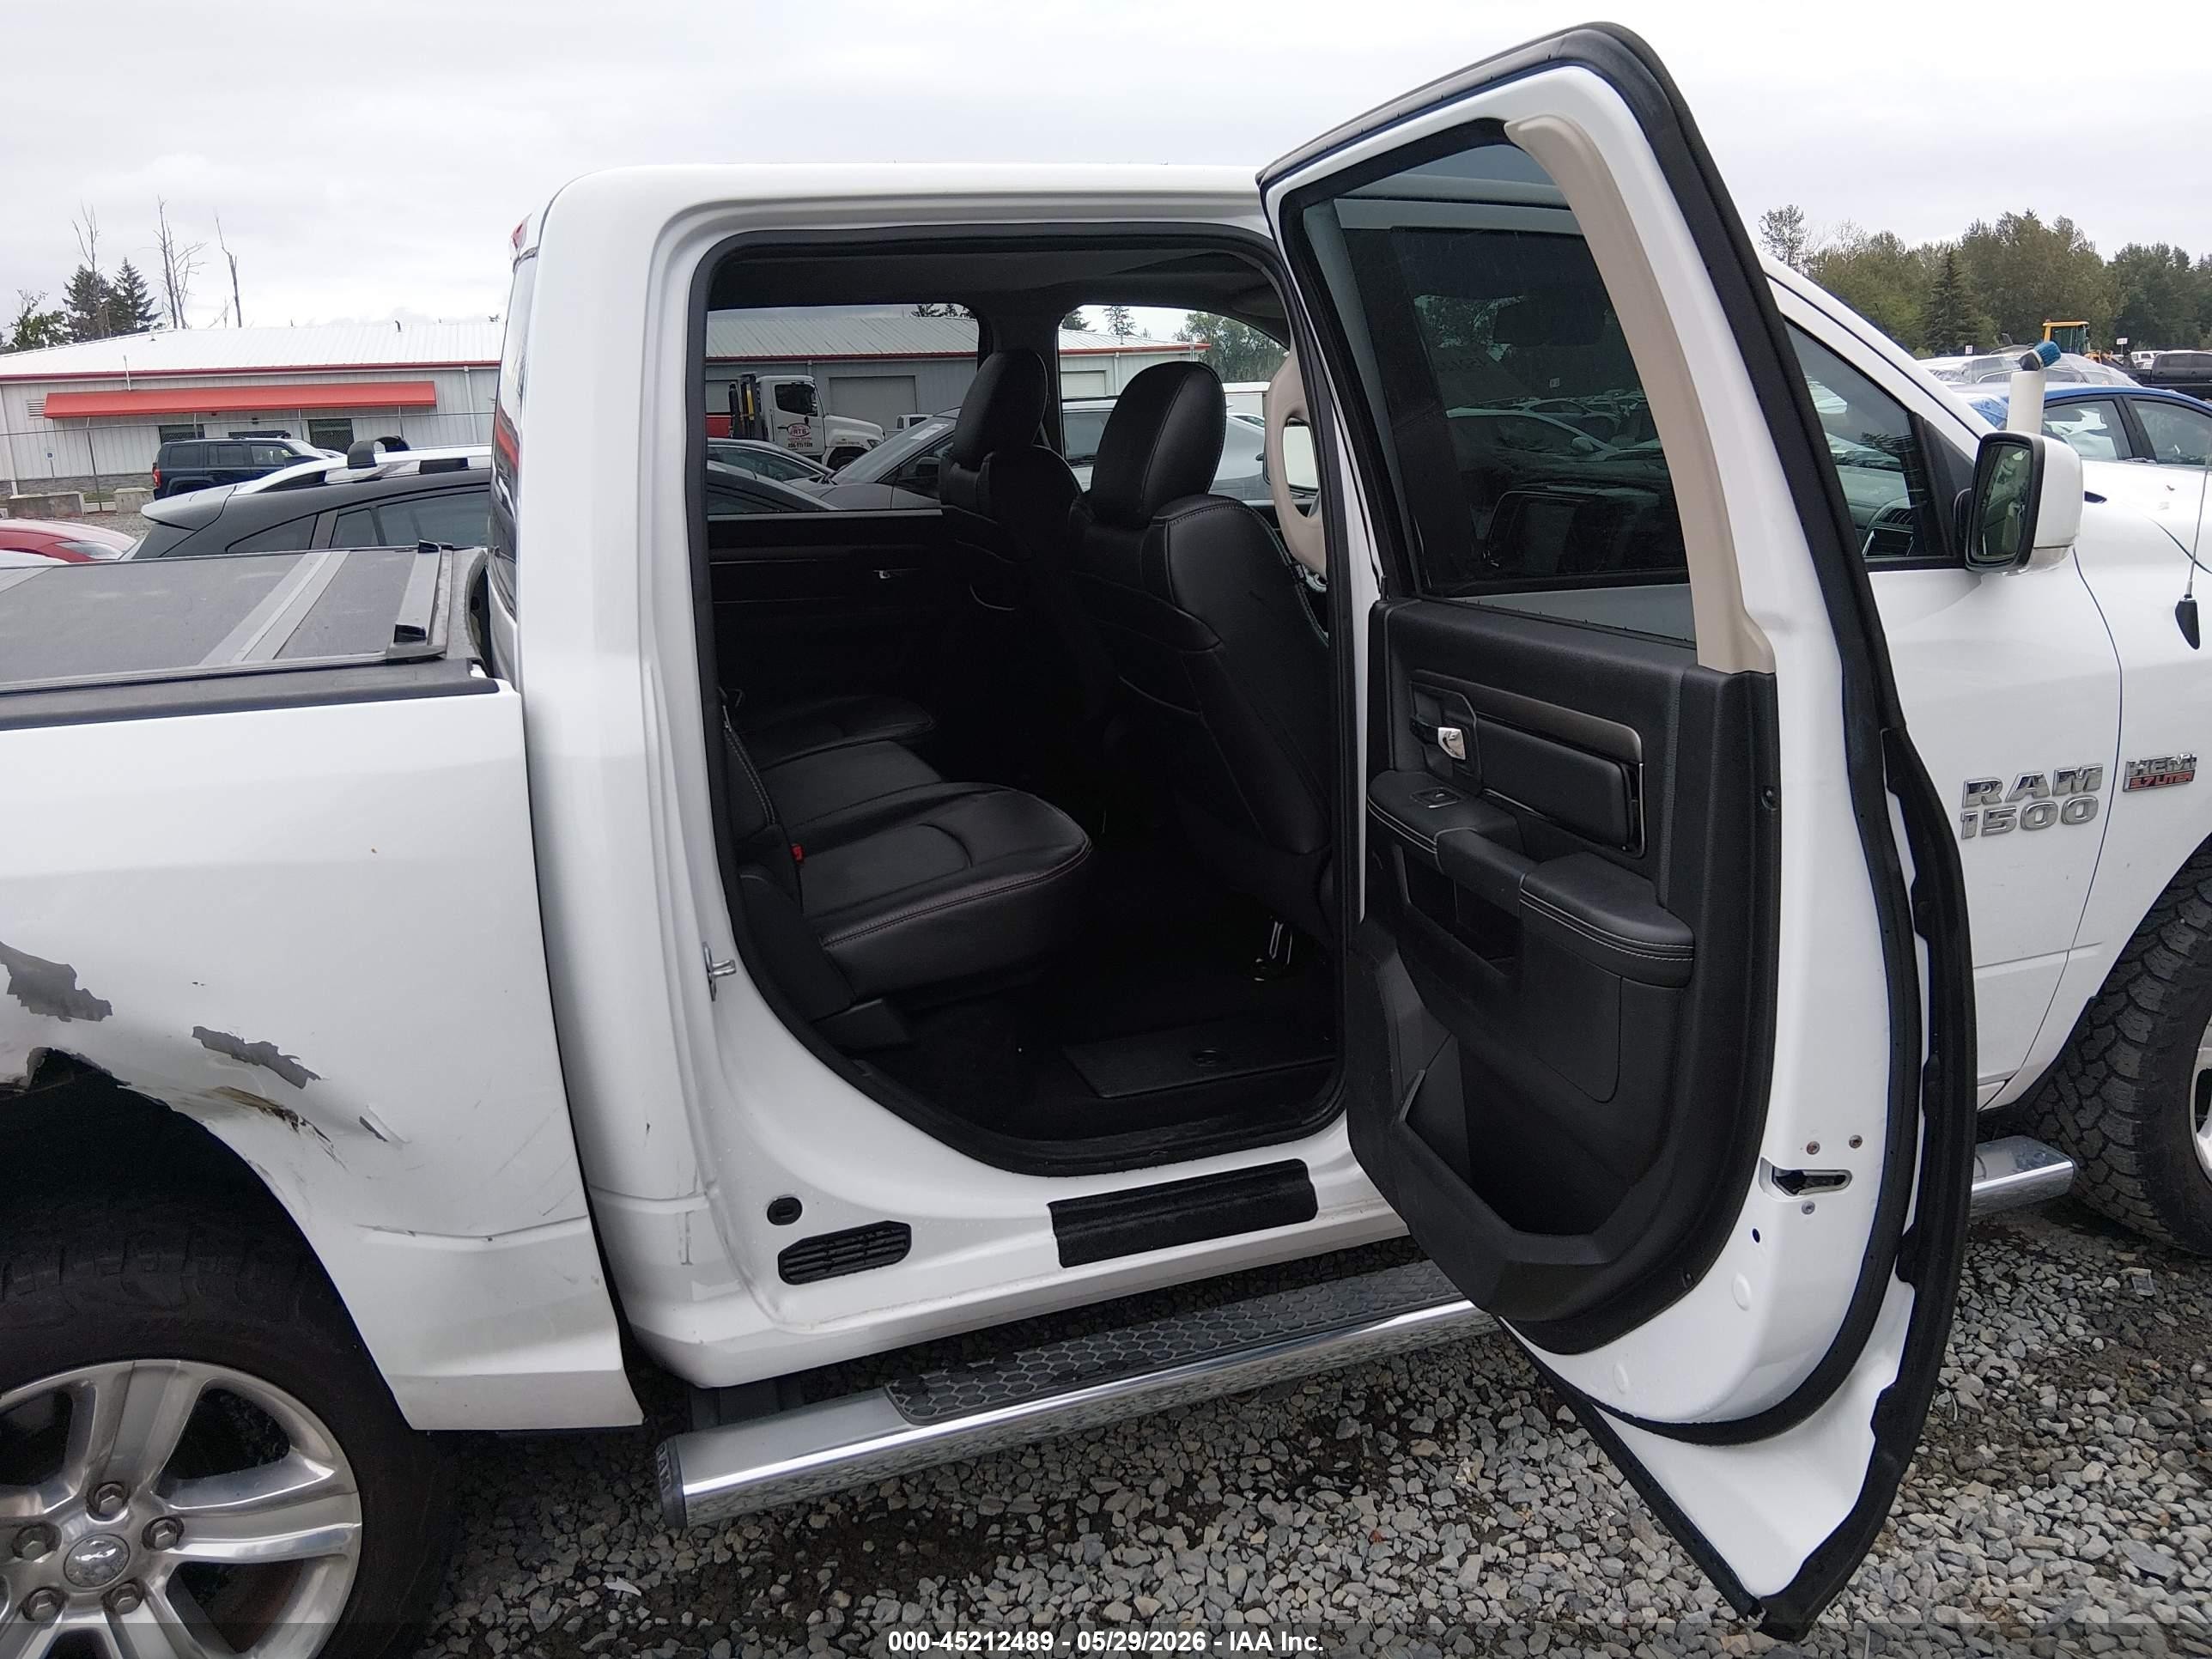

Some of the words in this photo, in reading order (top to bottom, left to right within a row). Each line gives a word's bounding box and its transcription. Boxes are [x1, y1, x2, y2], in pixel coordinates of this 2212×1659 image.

[1963, 763, 2104, 809] RAM
[2124, 754, 2197, 777] HEMI
[2156, 770, 2194, 785] LITER
[1960, 795, 2100, 840] 1500
[655, 1442, 672, 1492] RAM
